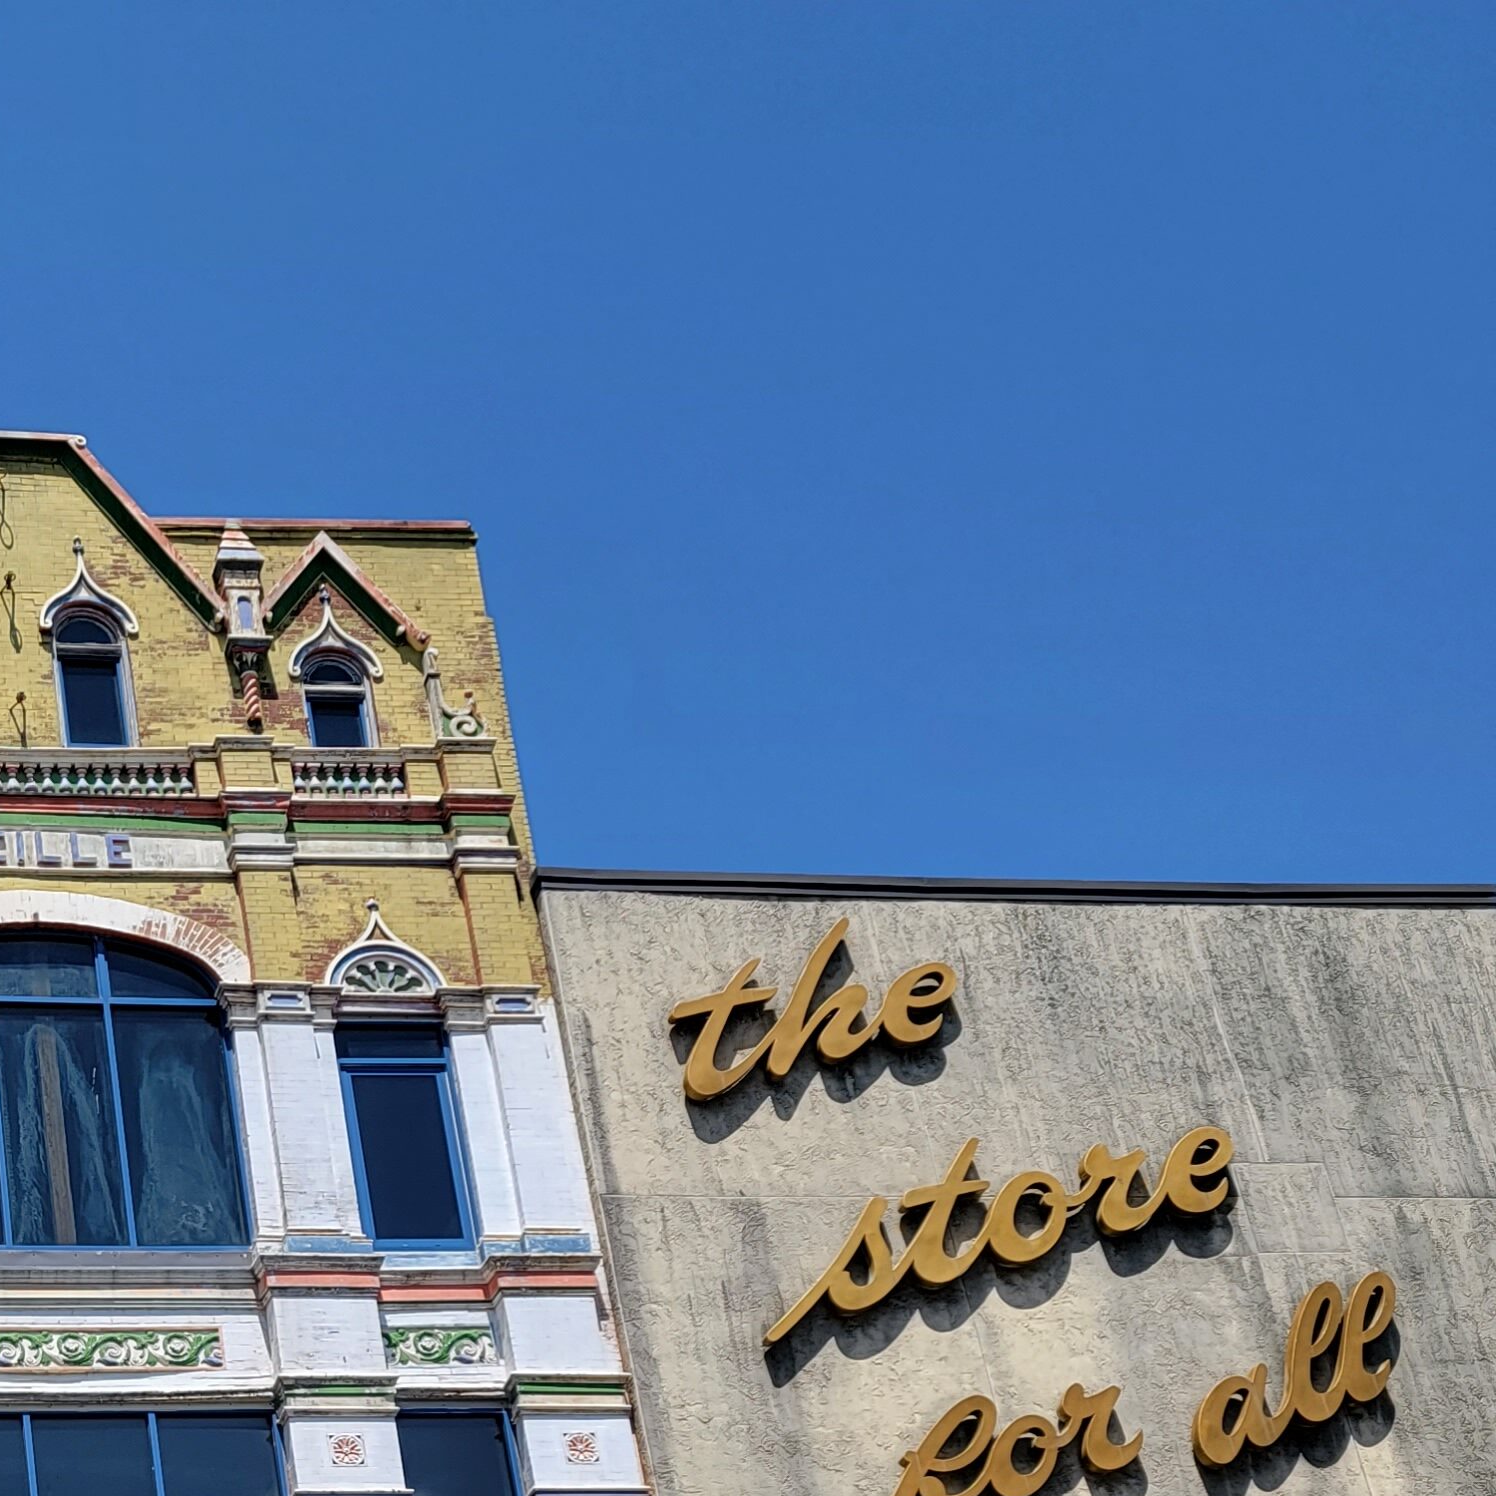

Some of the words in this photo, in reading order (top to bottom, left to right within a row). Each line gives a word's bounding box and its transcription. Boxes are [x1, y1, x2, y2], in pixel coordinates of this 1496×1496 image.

[668, 917, 956, 1101] the
[764, 1126, 1234, 1346] store
[1192, 1270, 1396, 1467] all
